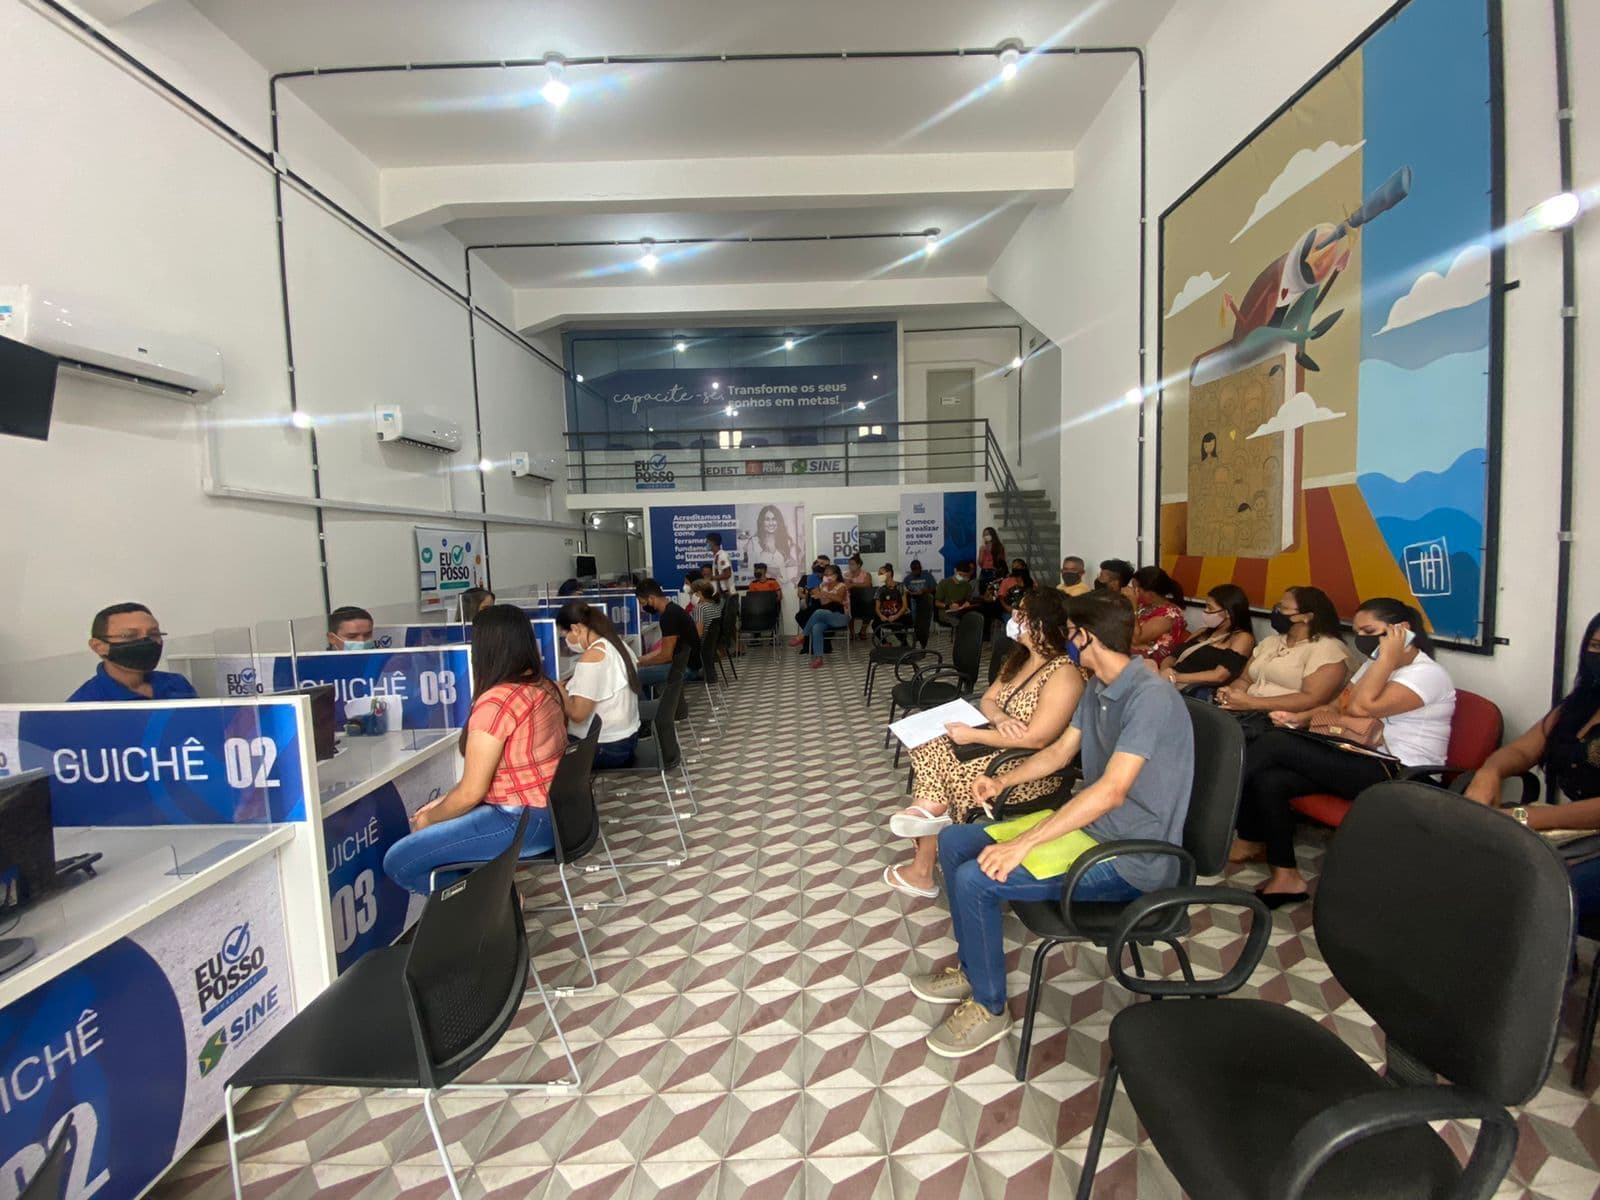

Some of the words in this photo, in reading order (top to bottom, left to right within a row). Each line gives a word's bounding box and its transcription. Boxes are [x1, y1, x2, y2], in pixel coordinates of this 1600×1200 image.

[728, 385, 798, 395] Transforme
[801, 384, 815, 393] os
[819, 383, 847, 392] seus
[775, 399, 794, 407] em
[798, 396, 839, 406] metas!
[635, 461, 650, 472] EU
[809, 460, 840, 471] SINE
[635, 471, 675, 483] POSSO
[674, 521, 736, 529] Empregabilidade
[833, 532, 851, 545] EU
[440, 552, 452, 567] EU
[676, 562, 700, 570] social.
[441, 566, 470, 581] POSSO
[227, 673, 241, 685] EU
[420, 670, 457, 705] 03
[53, 737, 208, 784] GUICHÊ
[224, 737, 281, 788] 02
[328, 816, 379, 875] UICHÊ
[331, 868, 378, 954] 03
[195, 951, 223, 990] EU
[199, 946, 265, 1014] POSSO
[230, 984, 278, 1042] SINE
[0, 1009, 104, 1114] ICHÊ
